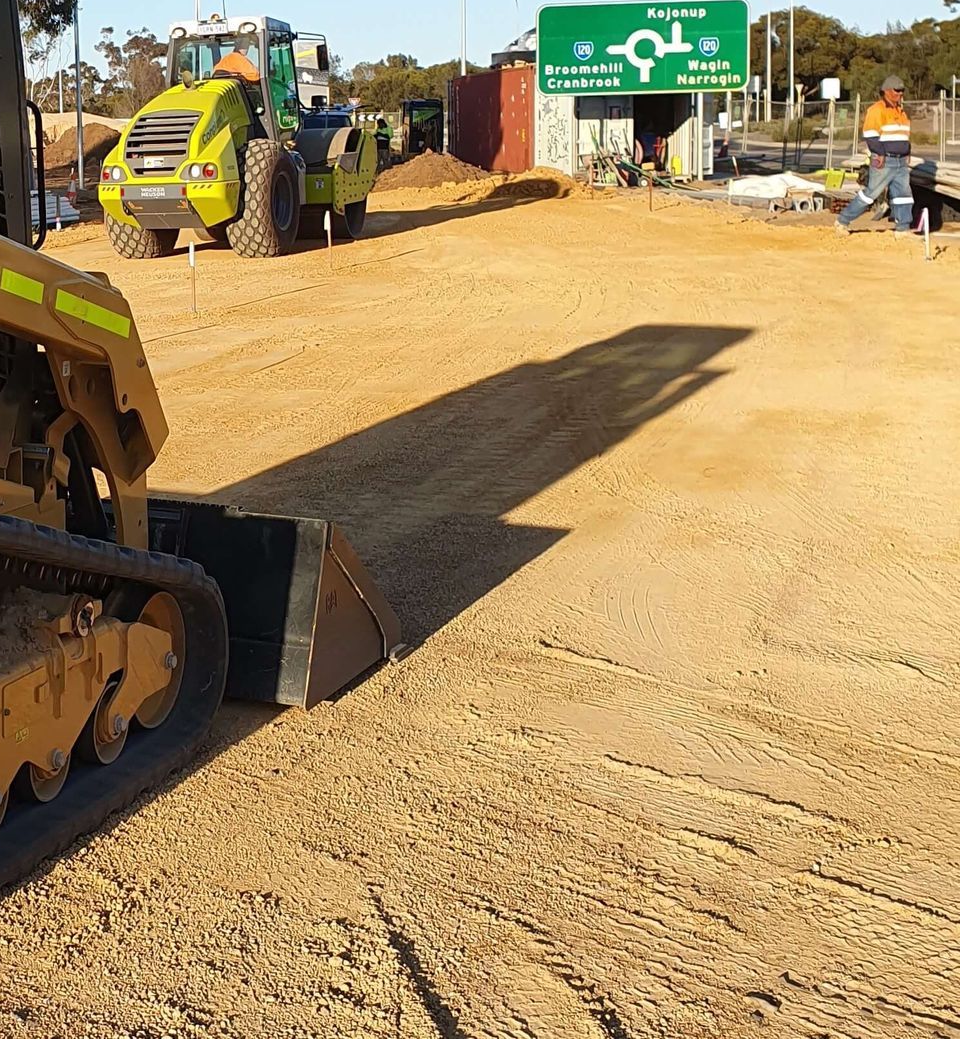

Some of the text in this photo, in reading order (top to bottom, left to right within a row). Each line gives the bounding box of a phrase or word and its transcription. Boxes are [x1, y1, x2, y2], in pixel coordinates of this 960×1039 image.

[647, 7, 707, 21] Kojonup
[577, 44, 591, 56] 120
[702, 40, 717, 52] 120
[544, 62, 623, 75] Broomehill
[687, 59, 731, 73] Wagin
[547, 76, 621, 89] Cranbrook
[677, 72, 741, 87] Narrogin
